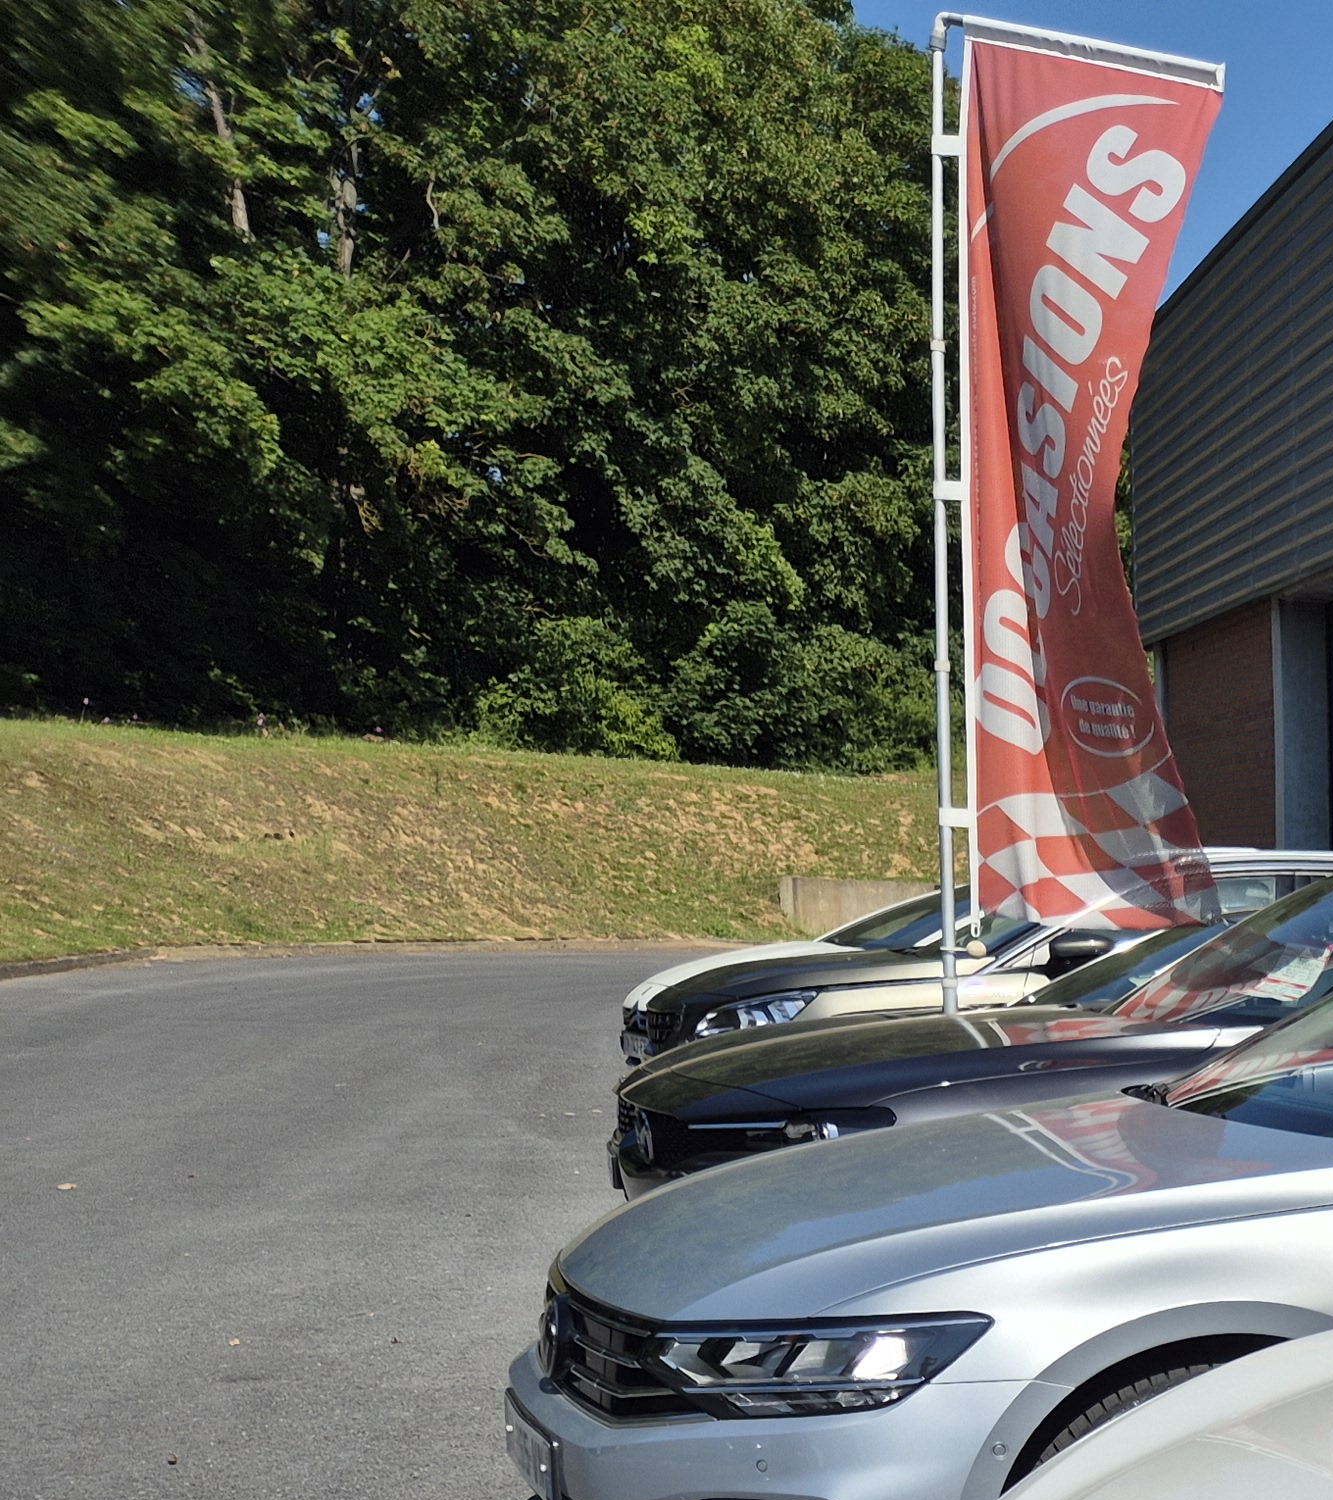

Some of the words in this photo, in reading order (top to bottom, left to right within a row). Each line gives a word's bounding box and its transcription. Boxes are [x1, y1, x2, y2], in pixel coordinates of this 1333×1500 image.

[1053, 355, 1129, 616] Sélectionnées
[1070, 695, 1089, 712] Une
[1089, 700, 1135, 718] garantie
